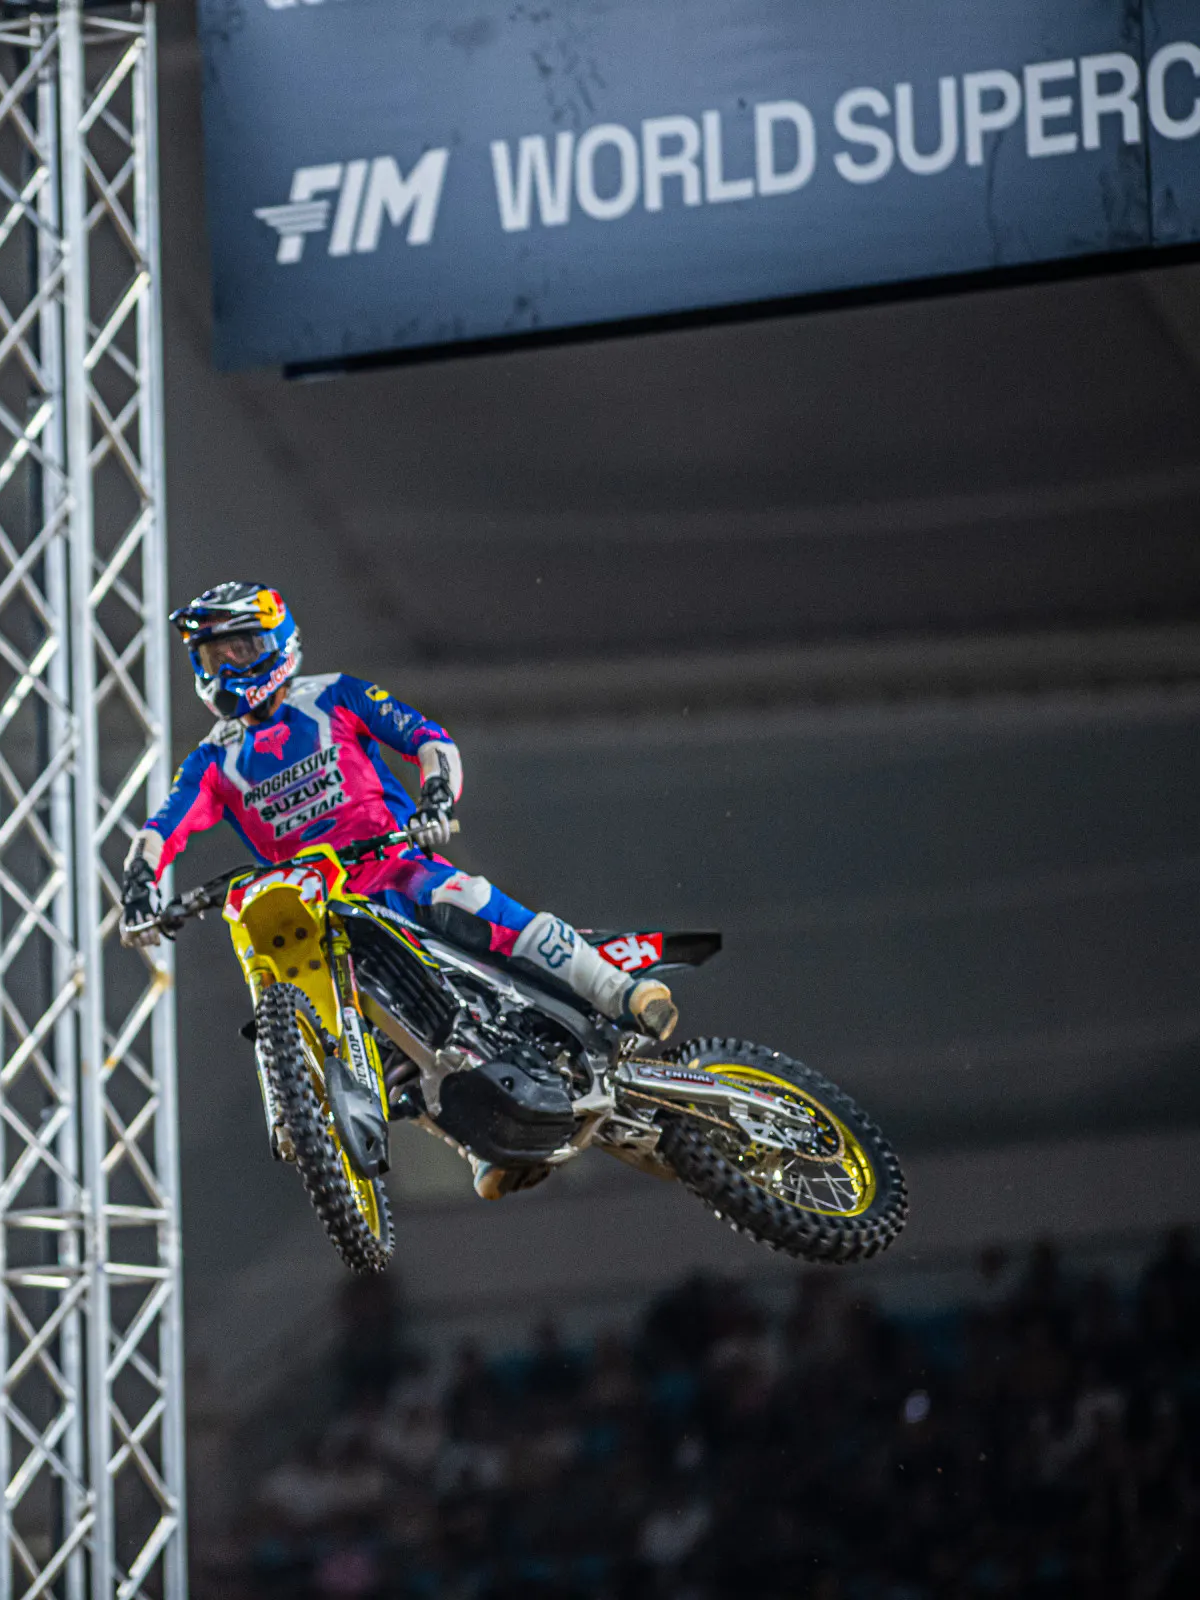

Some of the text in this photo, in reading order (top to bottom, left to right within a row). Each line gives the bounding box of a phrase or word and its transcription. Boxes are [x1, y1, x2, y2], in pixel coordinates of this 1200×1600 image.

[256, 41, 1200, 264] FIM WORLD SUPERC
[245, 669, 278, 709] Red
[244, 745, 341, 809] PROGRESSIVE
[260, 769, 344, 822] SUZUKI
[275, 791, 345, 839] ECSTAR
[603, 936, 659, 972] 94
[349, 1034, 369, 1087] DUNLOP
